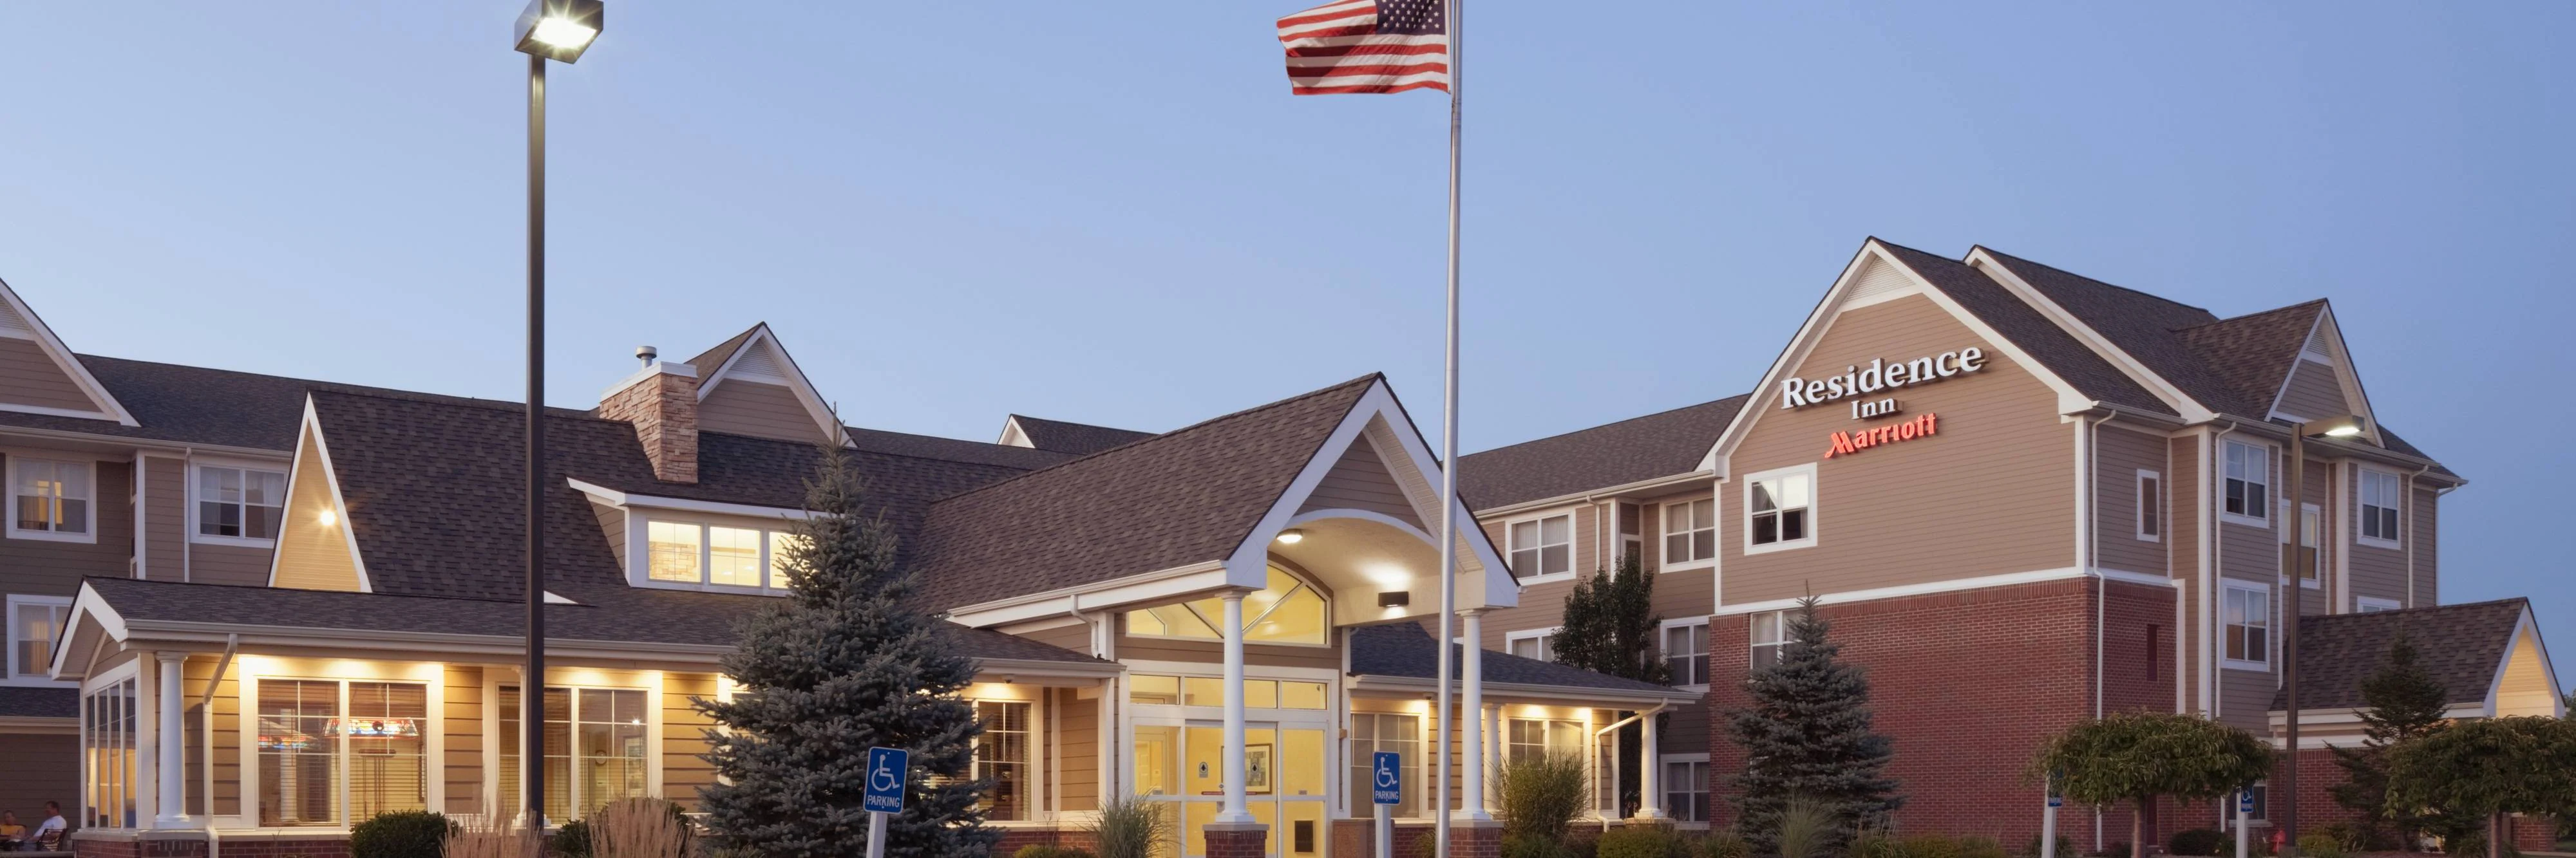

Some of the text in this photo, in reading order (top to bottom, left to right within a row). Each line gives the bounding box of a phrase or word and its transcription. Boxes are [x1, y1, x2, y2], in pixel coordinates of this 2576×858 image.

[1781, 346, 1987, 409] Residence
[1851, 397, 1899, 420] Inn
[1824, 412, 1938, 459] Marriott
[867, 795, 900, 808] PARKING
[1375, 790, 1399, 800] PARKING
